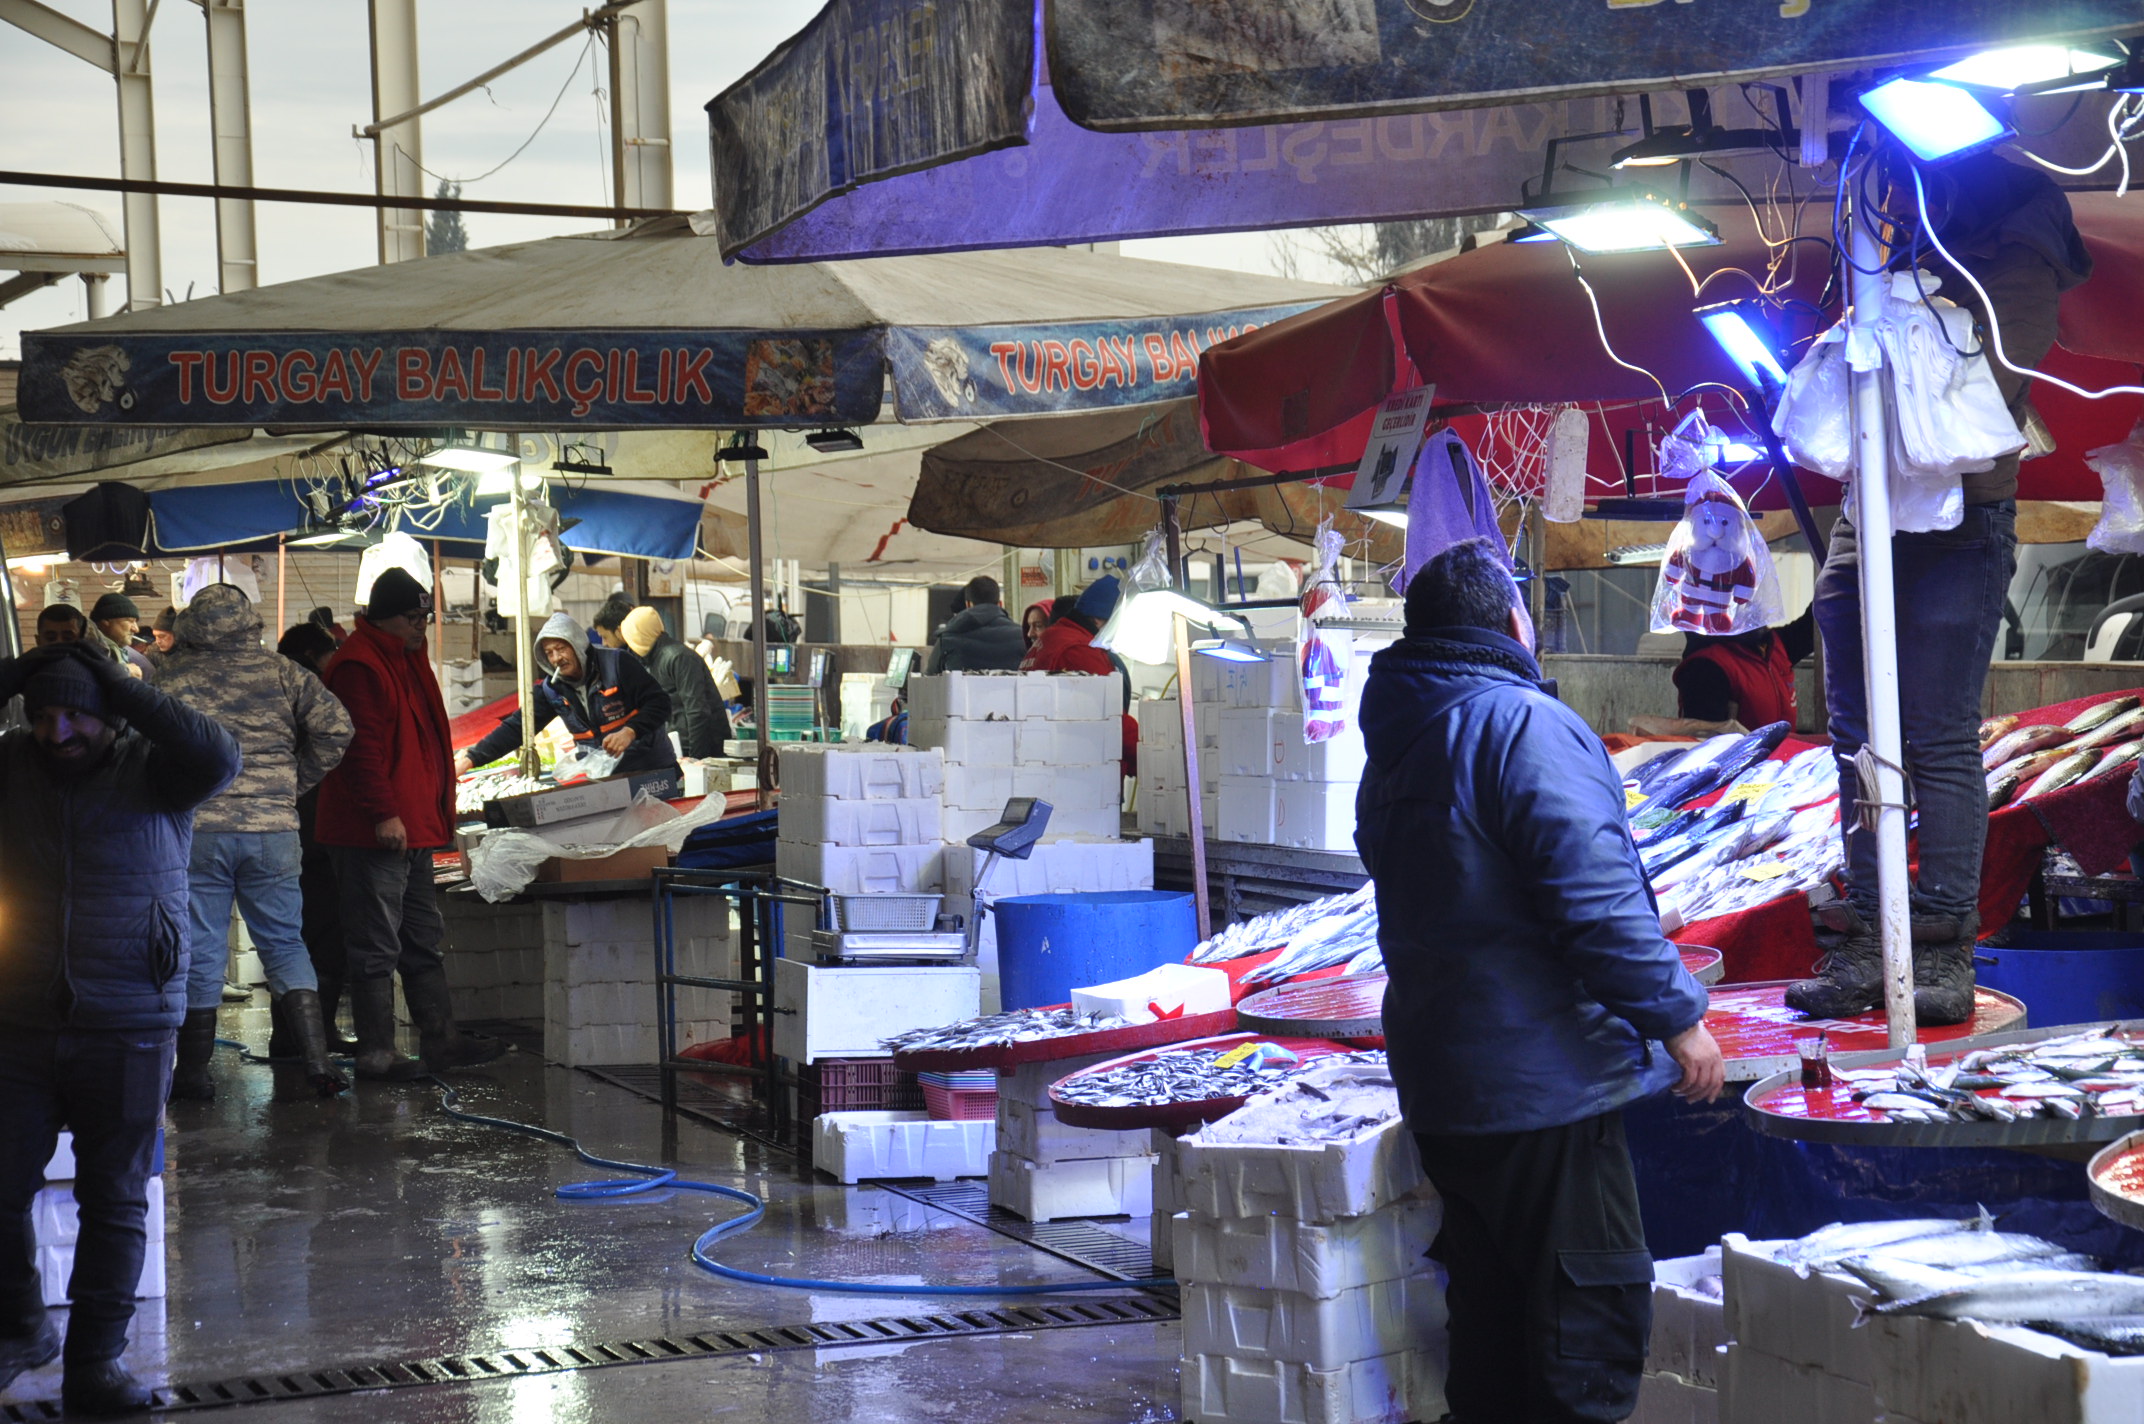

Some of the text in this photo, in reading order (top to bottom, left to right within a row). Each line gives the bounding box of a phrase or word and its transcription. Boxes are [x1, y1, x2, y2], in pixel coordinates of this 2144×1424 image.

[168, 346, 713, 417] TURGAY BALIKÇILIK
[990, 335, 1137, 395] TURGAY
